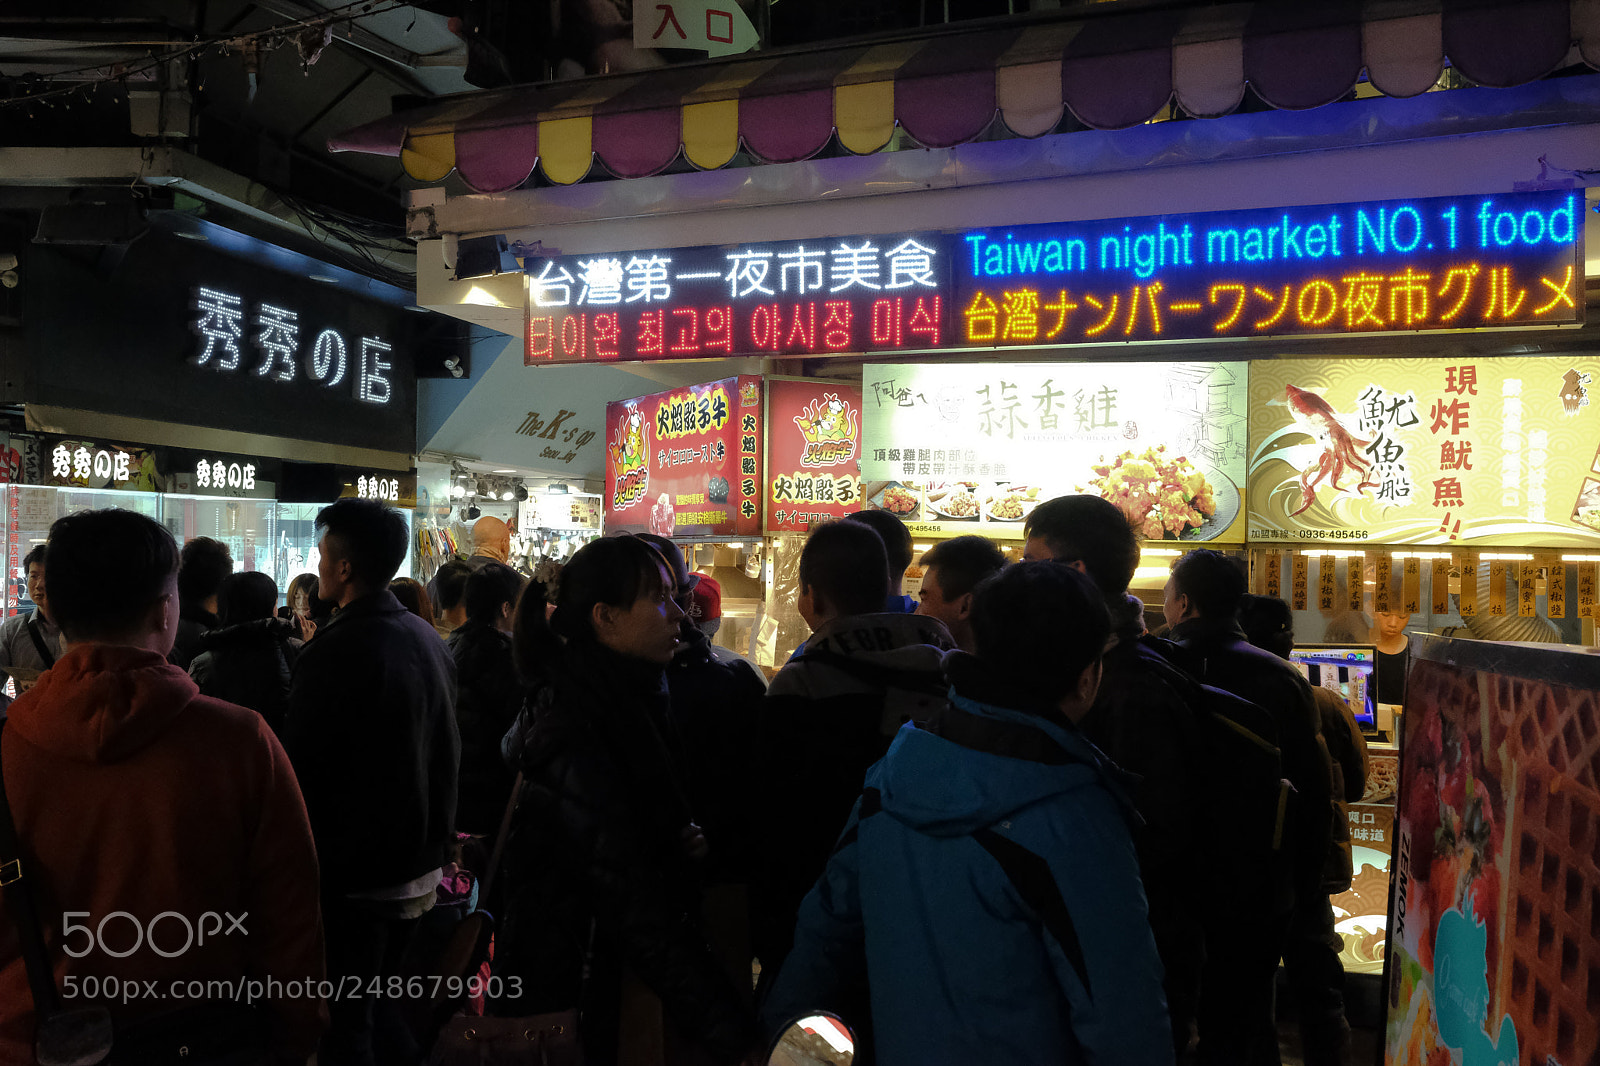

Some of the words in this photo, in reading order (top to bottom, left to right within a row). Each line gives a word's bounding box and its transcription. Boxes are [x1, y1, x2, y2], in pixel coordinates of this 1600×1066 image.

[652, 4, 734, 44] 入口
[965, 234, 1086, 276] Taiwan
[1101, 224, 1194, 278] night
[1206, 215, 1341, 262] market
[1477, 195, 1575, 247] food
[533, 238, 938, 307] 台灣第一夜市美食
[530, 312, 621, 358] 타이완
[637, 305, 731, 354] 최고의
[752, 301, 854, 349] 야시장
[873, 295, 941, 345] 미식
[965, 264, 1575, 341] 台湾ナンバーワンの夜市グルメ
[198, 287, 392, 403] 秀秀の店
[515, 411, 544, 436] The
[657, 395, 727, 435] 火焰骰子牛
[975, 379, 1119, 439] 蒜香雞
[52, 445, 130, 481] 秀秀の店
[1359, 387, 1420, 500] 魷魚船
[196, 459, 256, 489] 秀秀の店
[357, 475, 399, 500] 秀秀の店
[1349, 828, 1385, 842] 味道
